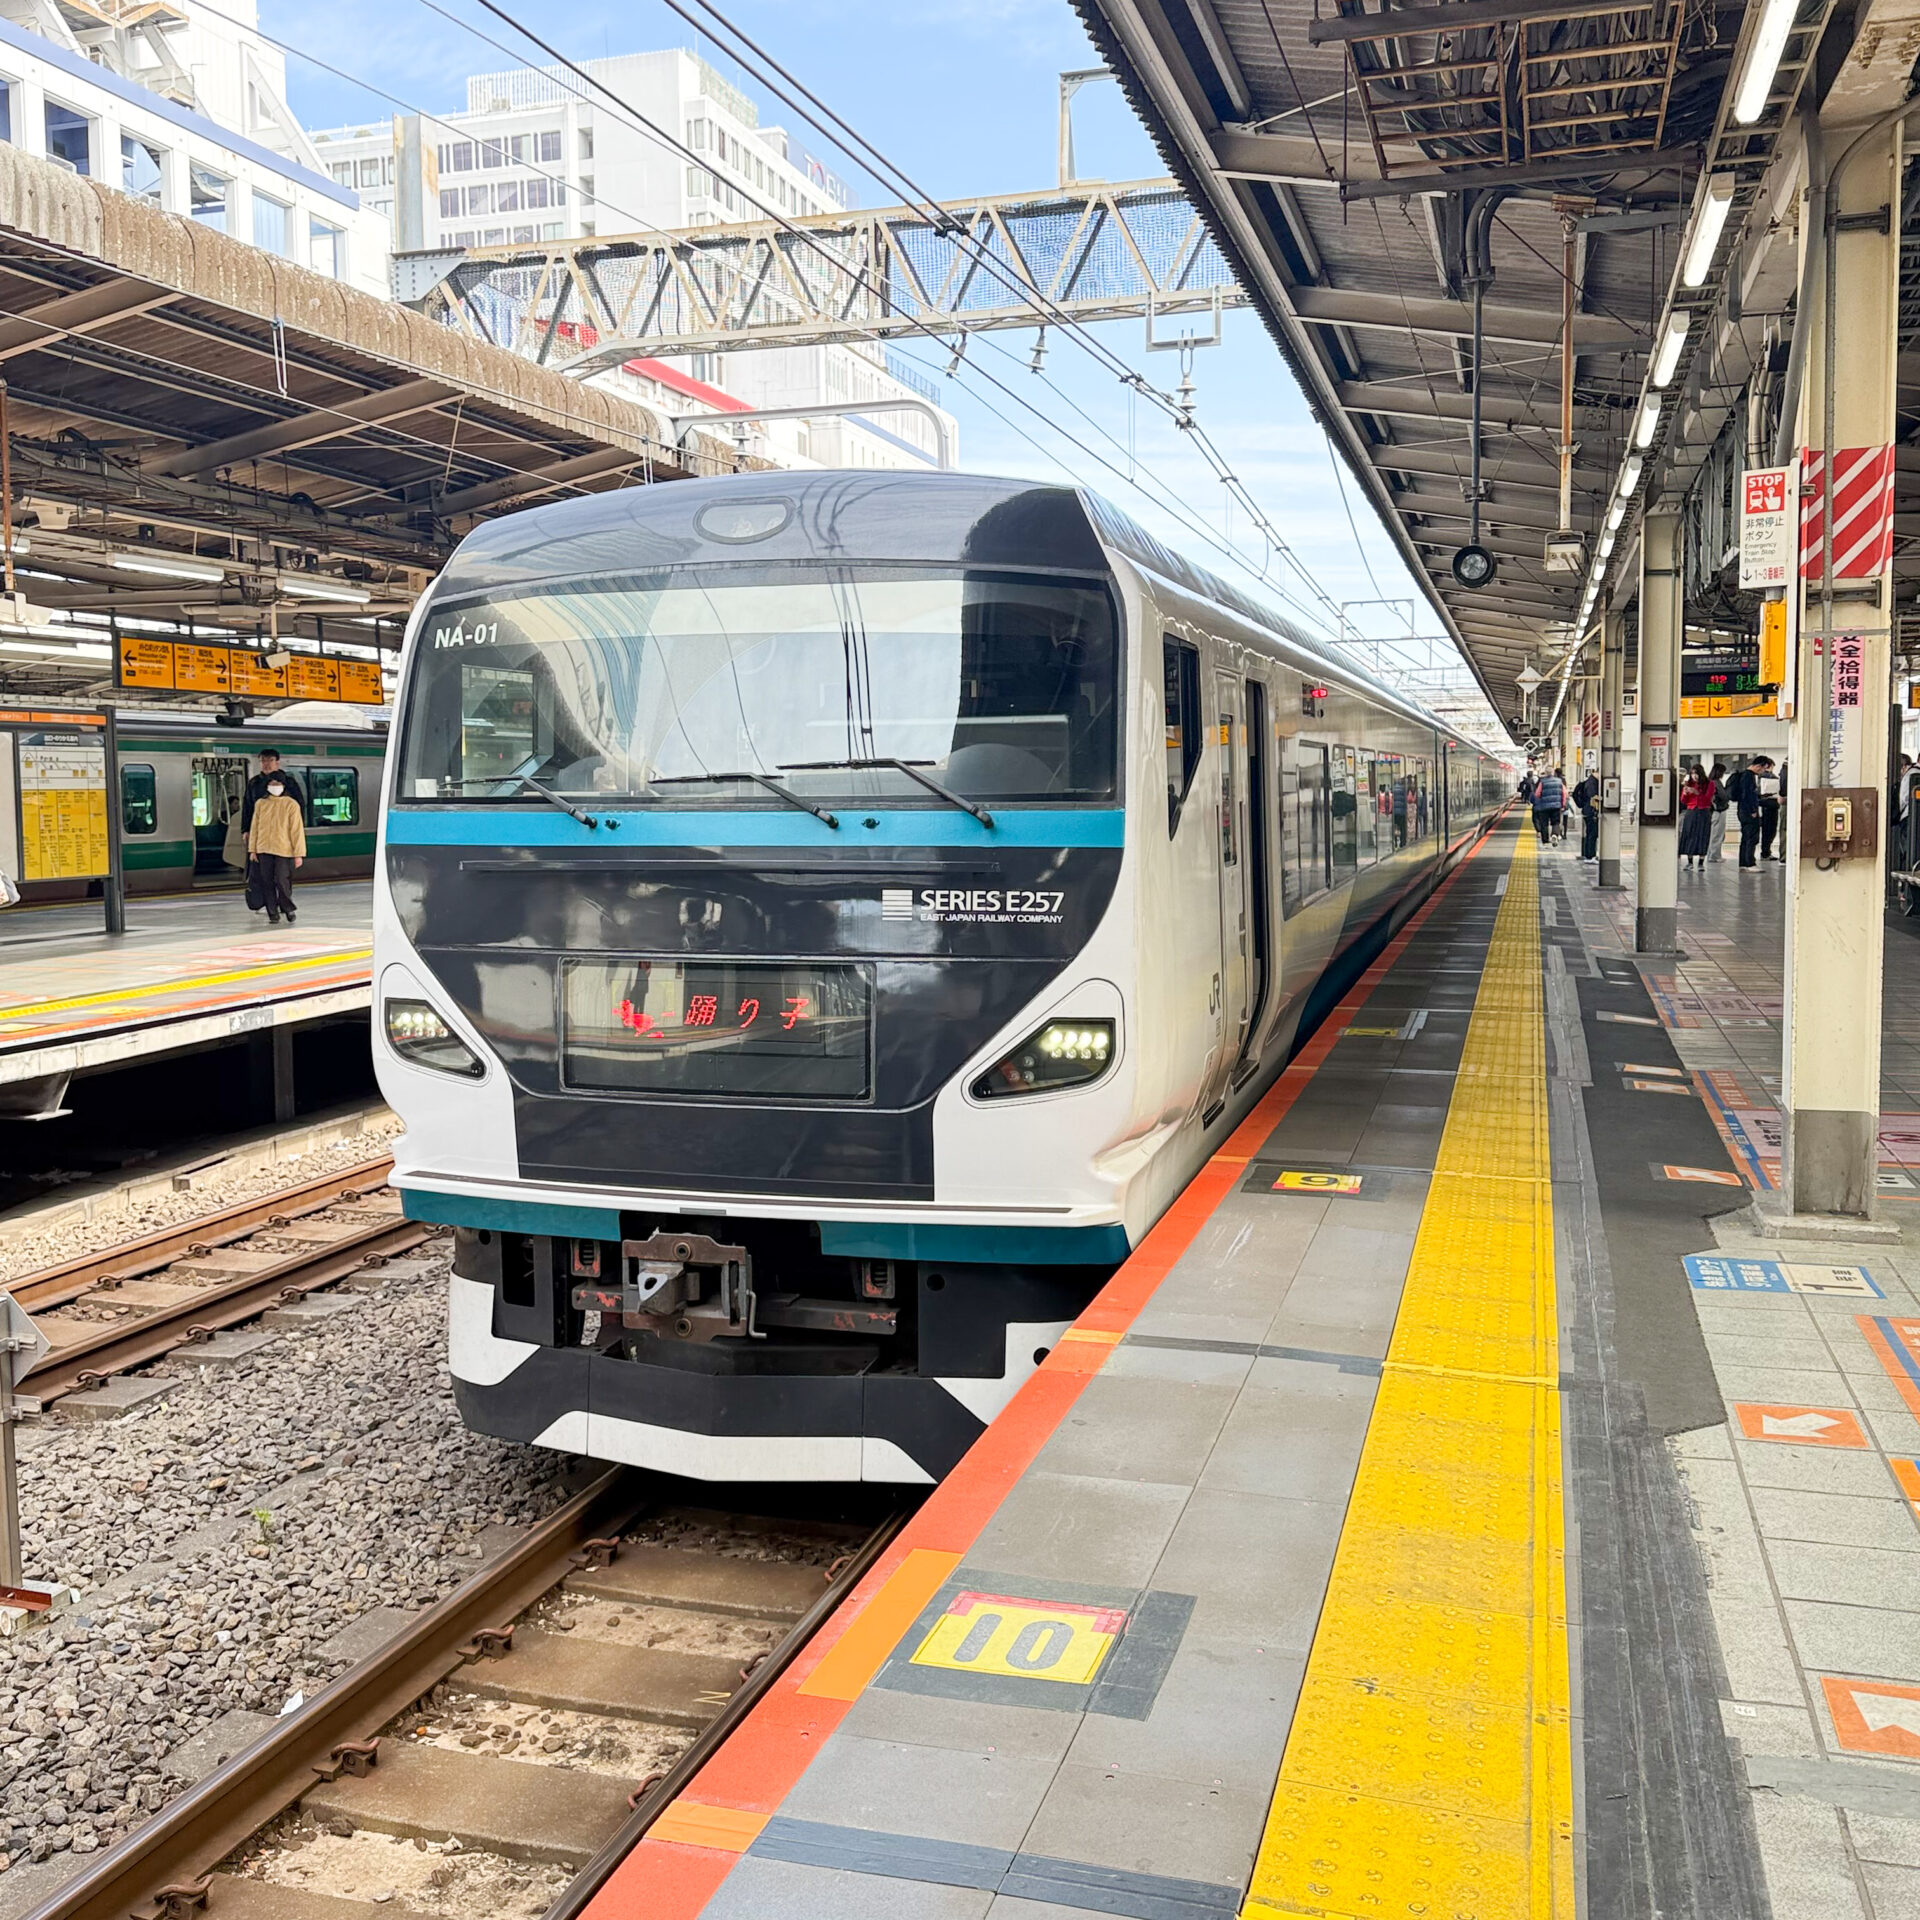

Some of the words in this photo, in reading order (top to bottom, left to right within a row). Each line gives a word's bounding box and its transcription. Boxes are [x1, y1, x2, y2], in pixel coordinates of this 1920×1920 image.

[1748, 475, 1783, 489] STOP
[1746, 516, 1784, 530] 非常停止
[1745, 530, 1774, 542] ボタン
[434, 622, 498, 649] NA-01
[920, 890, 1001, 912] SERIES
[1006, 891, 1065, 912] E257
[920, 913, 944, 922] EAST
[945, 913, 975, 922] JAPAN
[977, 914, 1016, 923] RAILWAY
[1017, 915, 1064, 924] COMPANY
[1209, 972, 1221, 1016] JR
[684, 995, 810, 1030] 踊り子
[953, 1613, 1075, 1670] 10
